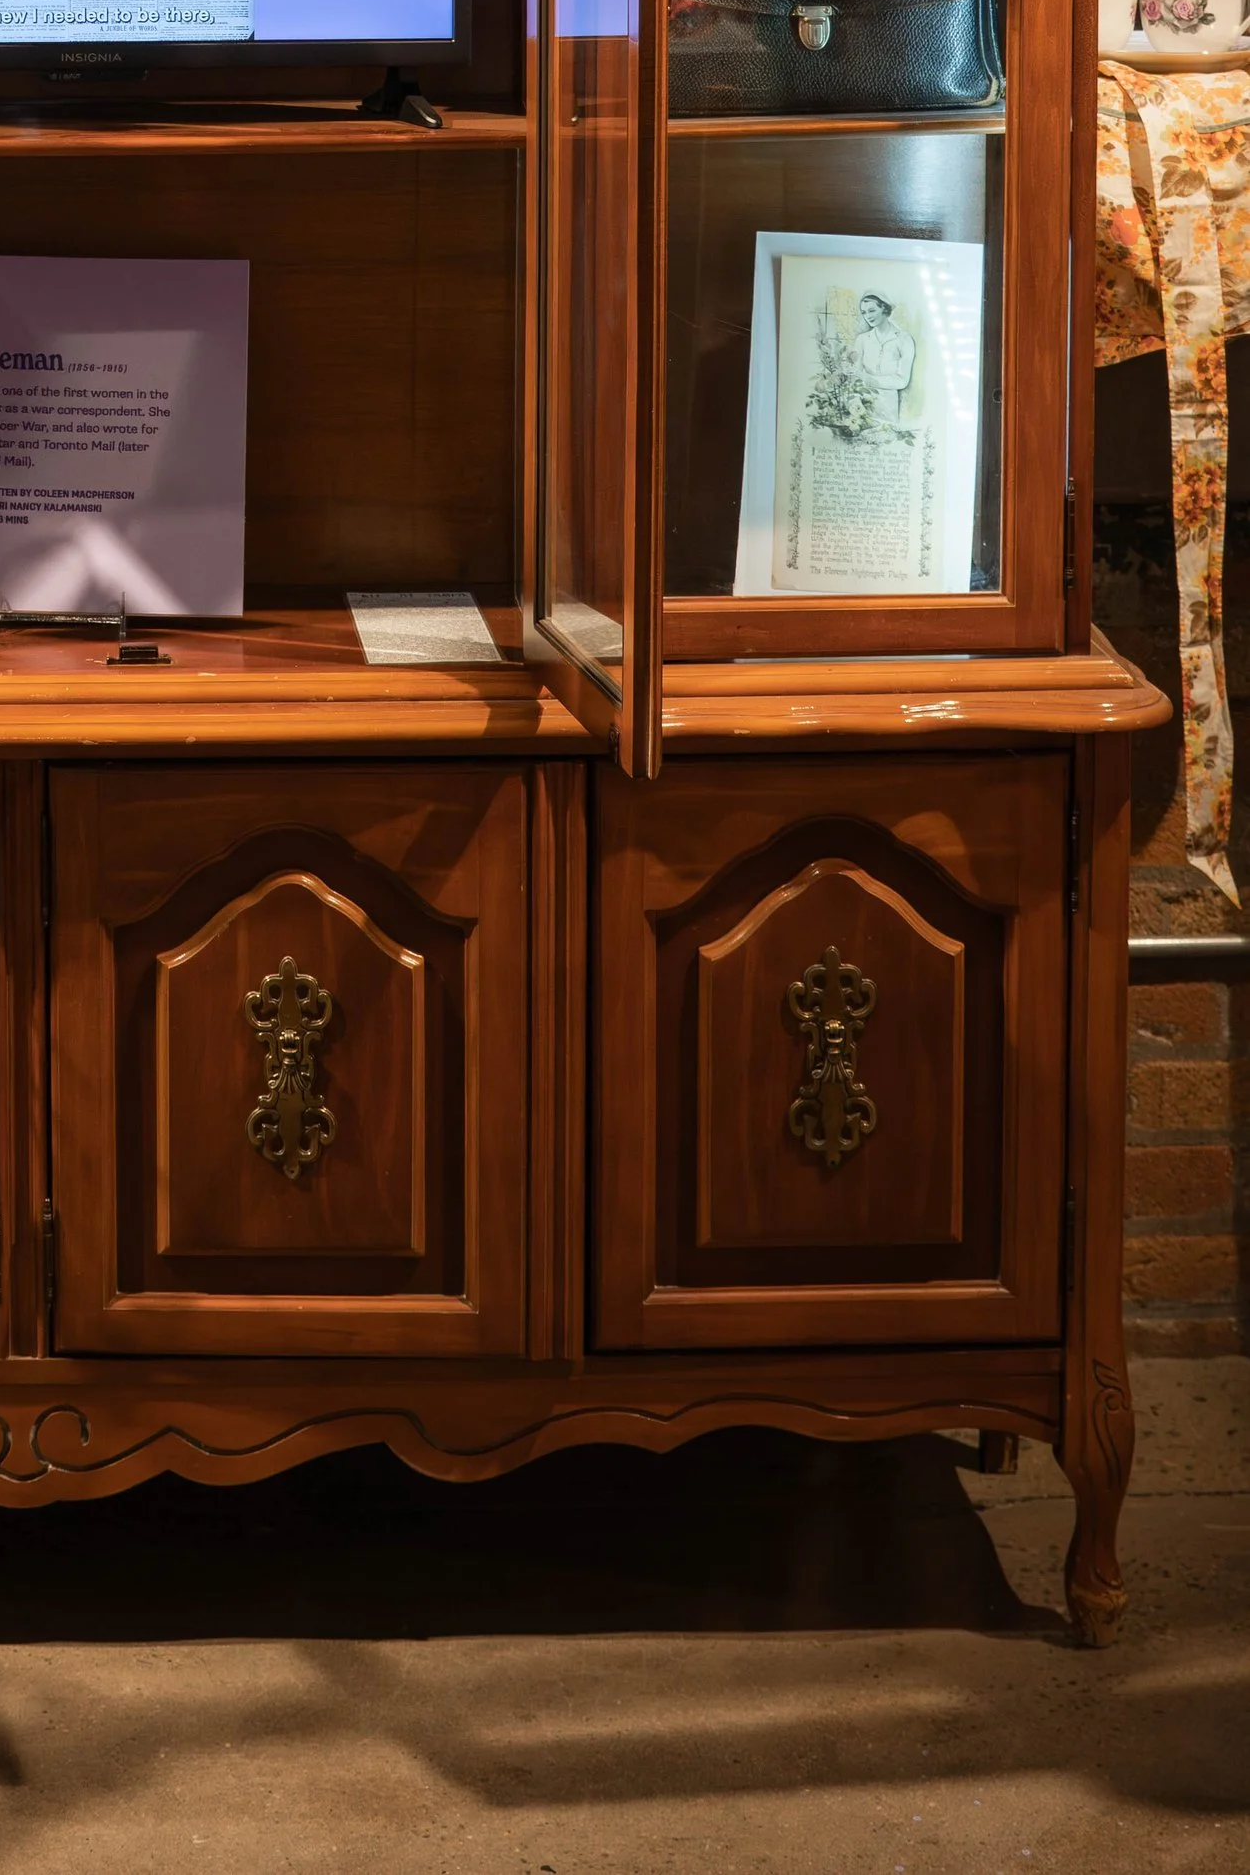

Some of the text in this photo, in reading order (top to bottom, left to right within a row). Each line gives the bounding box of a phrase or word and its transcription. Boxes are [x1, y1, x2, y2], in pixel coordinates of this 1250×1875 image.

[33, 8, 38, 24] I
[44, 8, 108, 23] needed
[114, 8, 132, 23] to
[138, 8, 160, 22] be
[165, 8, 216, 25] there,
[61, 53, 122, 62] INSIGNIA
[2, 388, 23, 396] one
[27, 386, 38, 396] of
[42, 386, 60, 397] the
[63, 387, 88, 398] first
[91, 391, 133, 399] women
[137, 389, 146, 399] in
[150, 390, 169, 400] the
[57, 406, 145, 418] correspondent.
[149, 406, 170, 417] She
[22, 421, 49, 433] War,
[53, 422, 73, 432] and
[76, 423, 99, 433] also
[103, 426, 137, 434] wrote
[141, 424, 158, 434] for
[18, 440, 39, 449] and
[44, 440, 88, 451] Toronto
[92, 441, 115, 451] Mail
[118, 441, 149, 453] (later
[20, 489, 31, 497] BY
[10, 502, 41, 511] NANCY
[6, 516, 28, 524] MINS
